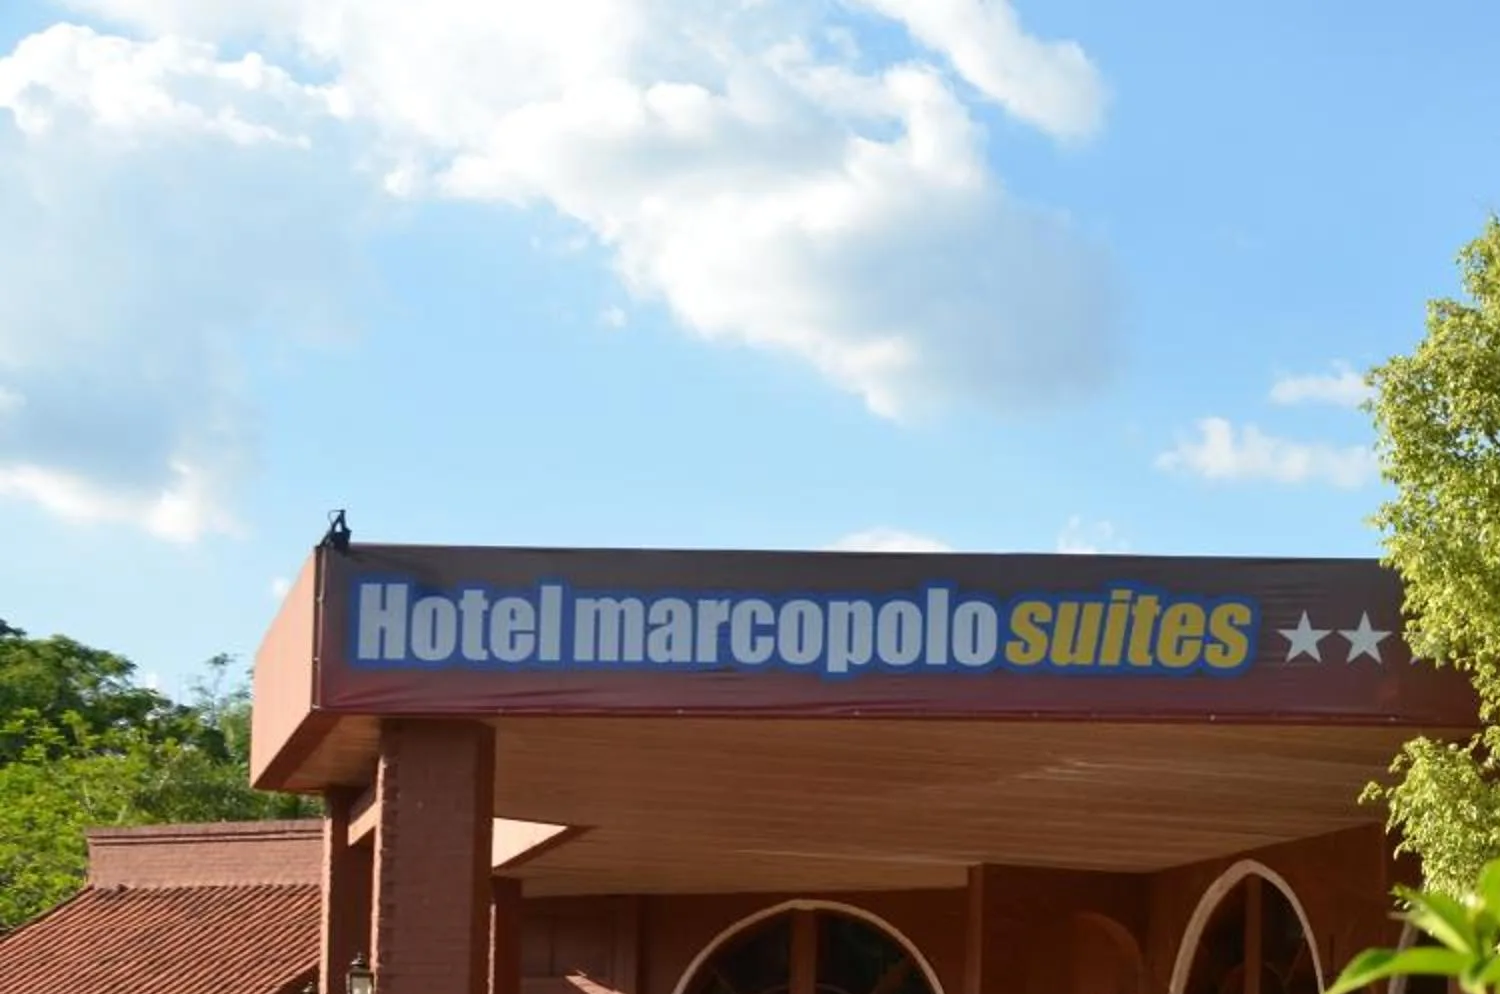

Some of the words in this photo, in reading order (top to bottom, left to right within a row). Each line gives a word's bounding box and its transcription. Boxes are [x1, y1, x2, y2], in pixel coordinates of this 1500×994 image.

[357, 582, 562, 662] Hotel
[573, 587, 998, 673] marcopolo
[1004, 589, 1252, 669] suites
